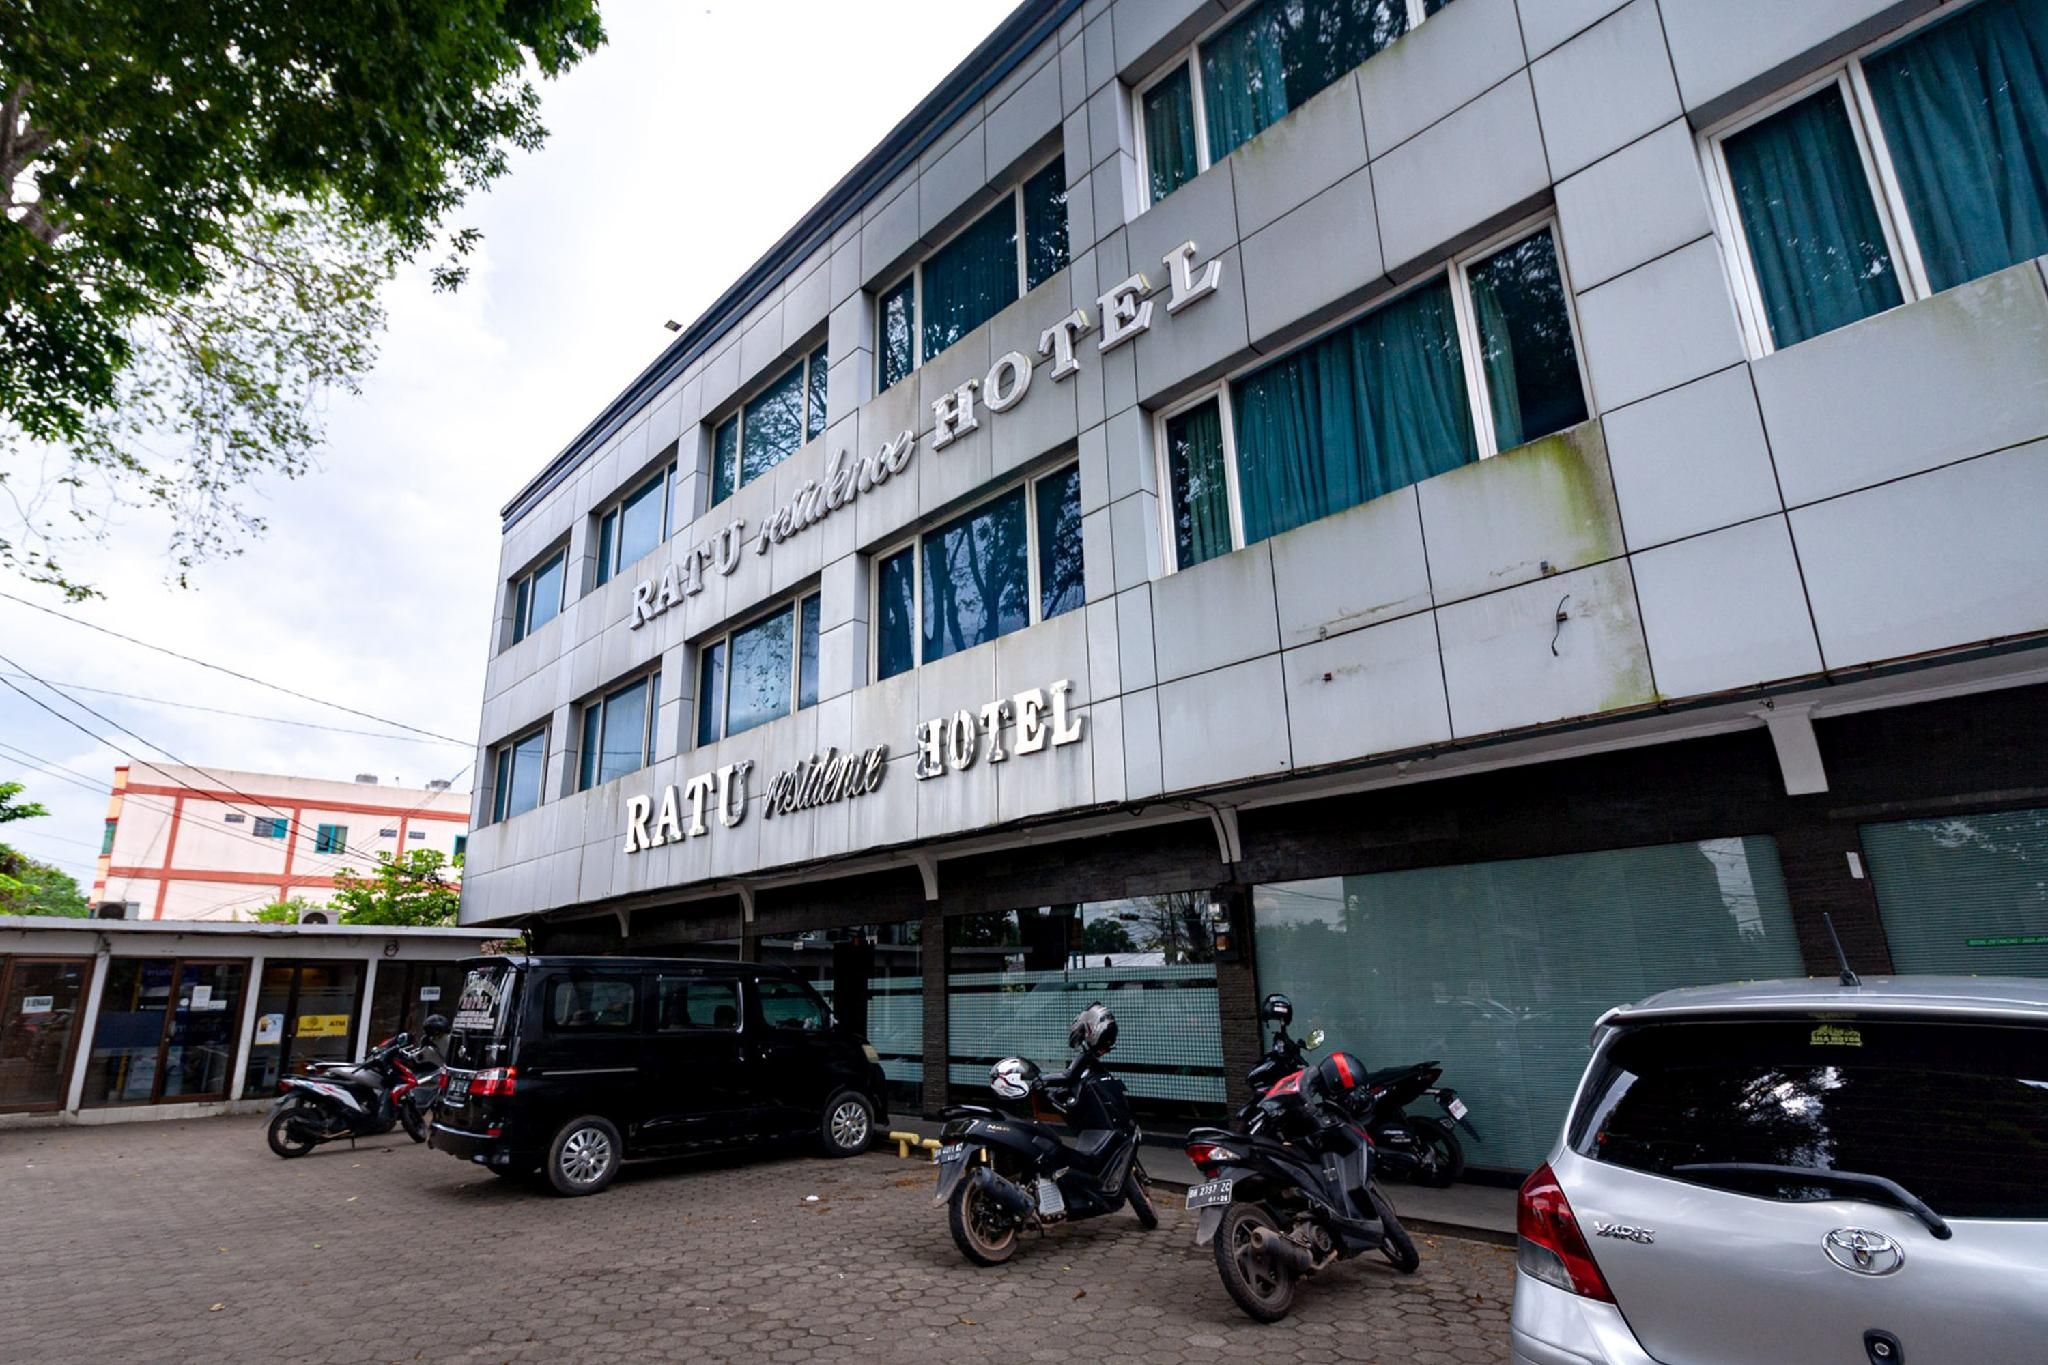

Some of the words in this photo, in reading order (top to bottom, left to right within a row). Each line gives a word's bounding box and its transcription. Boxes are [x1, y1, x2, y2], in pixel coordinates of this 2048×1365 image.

[630, 519, 743, 630] RATU
[756, 430, 915, 554] residence
[931, 240, 1223, 451] HOTEL
[624, 760, 754, 853] RATU
[764, 743, 888, 819] residence
[915, 679, 1086, 780] HOTEL
